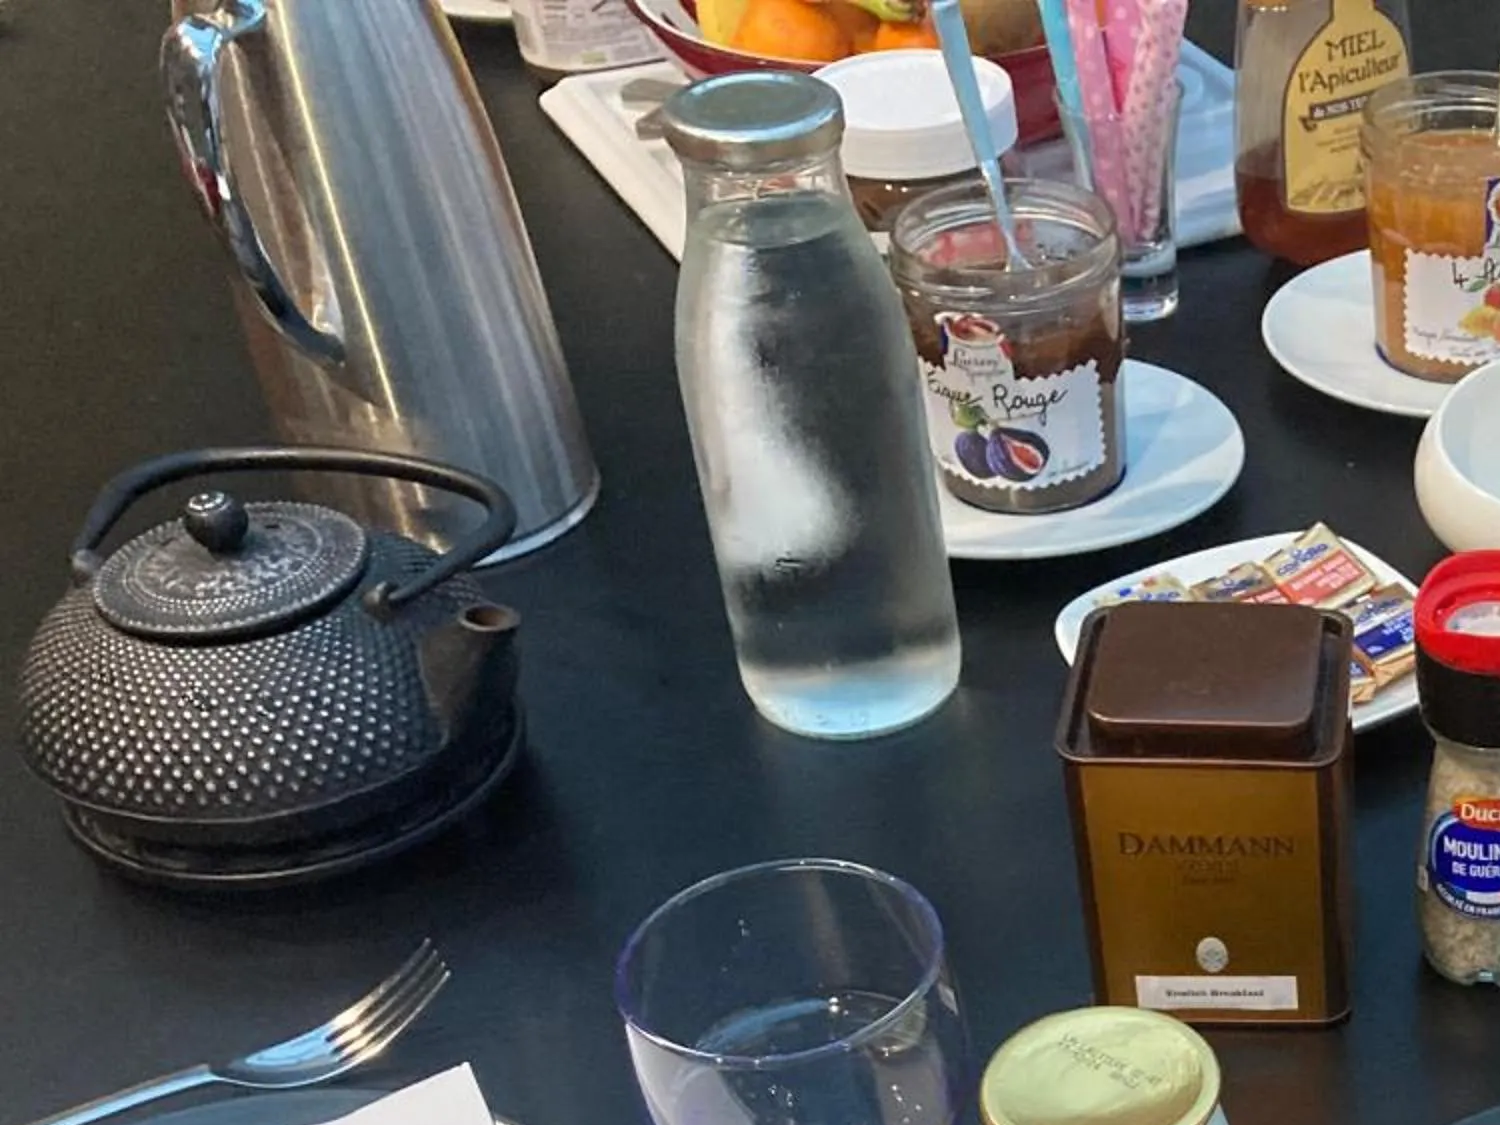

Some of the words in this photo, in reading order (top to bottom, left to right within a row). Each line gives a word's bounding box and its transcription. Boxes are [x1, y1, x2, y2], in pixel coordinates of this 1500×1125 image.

[1324, 29, 1386, 61] MIEL
[992, 383, 1069, 427] Rouge
[1118, 832, 1296, 856] DAMMANN
[1451, 861, 1467, 876] DE
